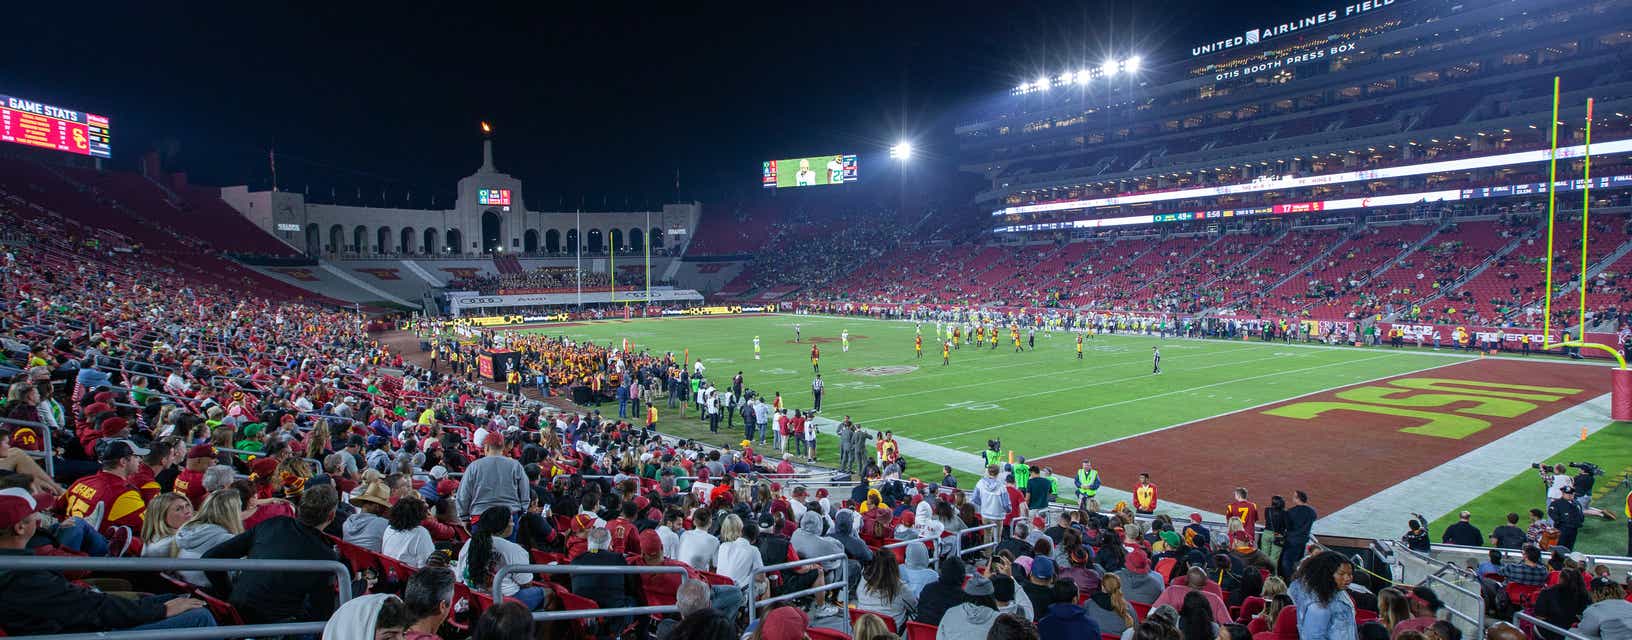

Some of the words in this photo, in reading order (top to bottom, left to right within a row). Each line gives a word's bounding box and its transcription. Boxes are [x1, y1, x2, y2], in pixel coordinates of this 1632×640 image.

[1192, 36, 1243, 56] UNITED
[1262, 10, 1337, 39] AIRLINES
[1345, 0, 1395, 16] FIELD
[1216, 69, 1240, 81] OTIS
[1244, 60, 1282, 75] BOOTH
[1287, 50, 1325, 65] PRESS
[1330, 42, 1356, 55] BOX
[9, 97, 43, 115] GAME
[44, 105, 79, 122] STATS
[1238, 507, 1249, 524] 7
